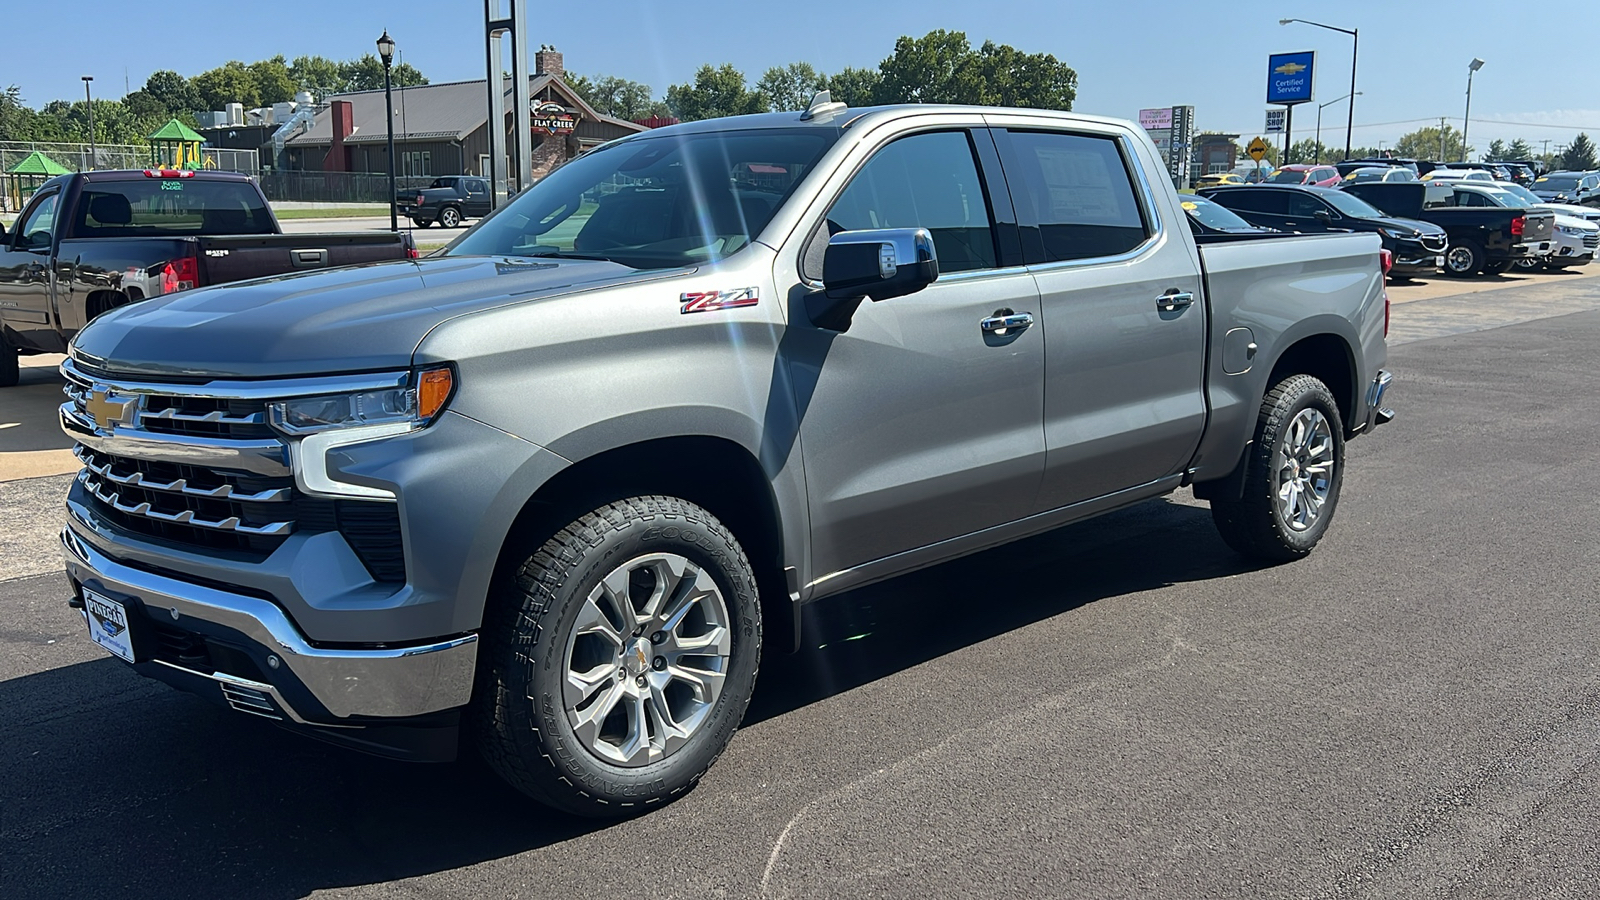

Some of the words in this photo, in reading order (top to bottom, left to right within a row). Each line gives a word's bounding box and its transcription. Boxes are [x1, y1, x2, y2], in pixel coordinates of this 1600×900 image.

[1275, 79, 1304, 87] Certified
[1277, 86, 1301, 94] Service
[534, 119, 550, 127] FLAT
[552, 120, 574, 128] CREEK
[1266, 119, 1284, 127] SHOP
[1267, 111, 1285, 119] BODY
[1173, 108, 1181, 152] WILDWOOD
[1171, 154, 1179, 179] PLAZA
[680, 286, 759, 314] Z71
[642, 525, 754, 638] GOODYEAR
[87, 599, 126, 629] PINEGAR
[541, 691, 667, 797] WRANGLER
